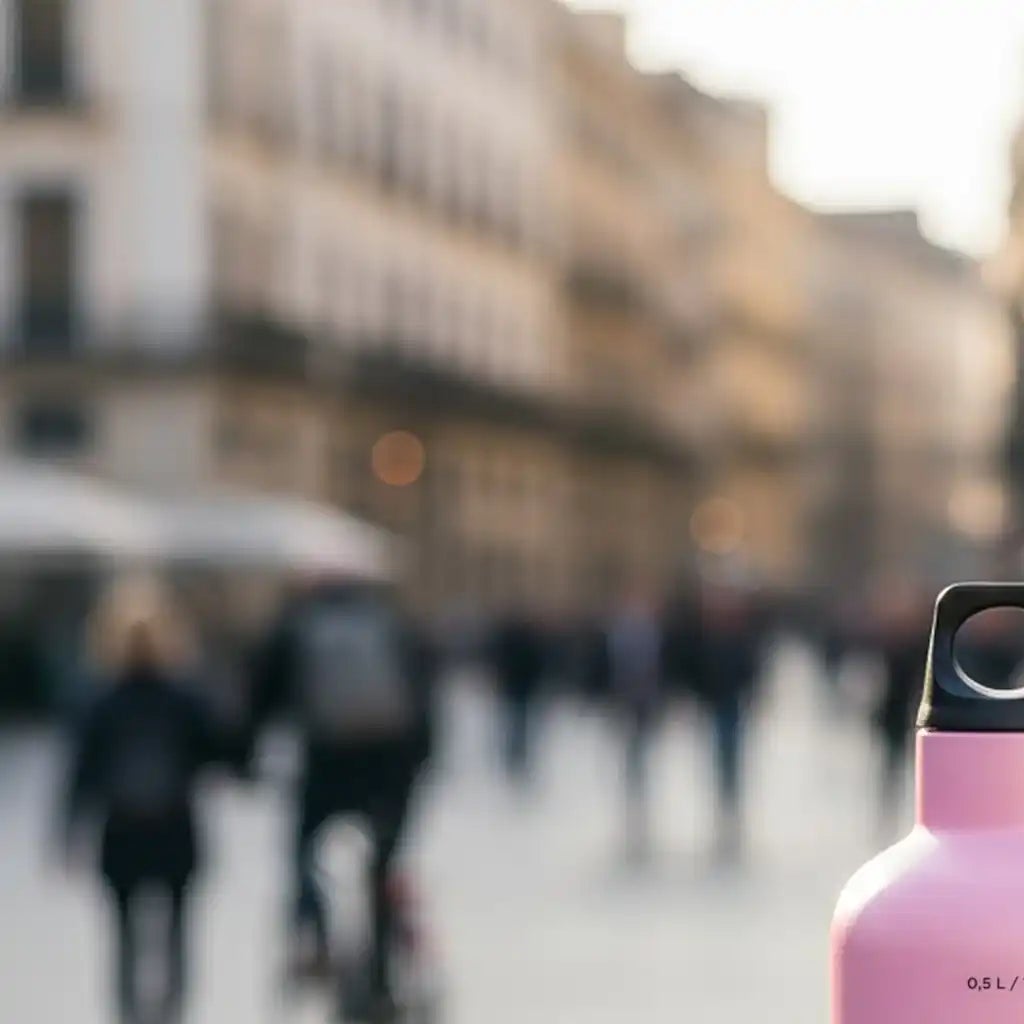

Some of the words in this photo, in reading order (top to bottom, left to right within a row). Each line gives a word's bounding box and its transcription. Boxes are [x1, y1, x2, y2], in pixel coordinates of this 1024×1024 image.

[967, 976, 992, 991] 0,5
[996, 977, 1006, 990] L
[1009, 976, 1019, 991] /
